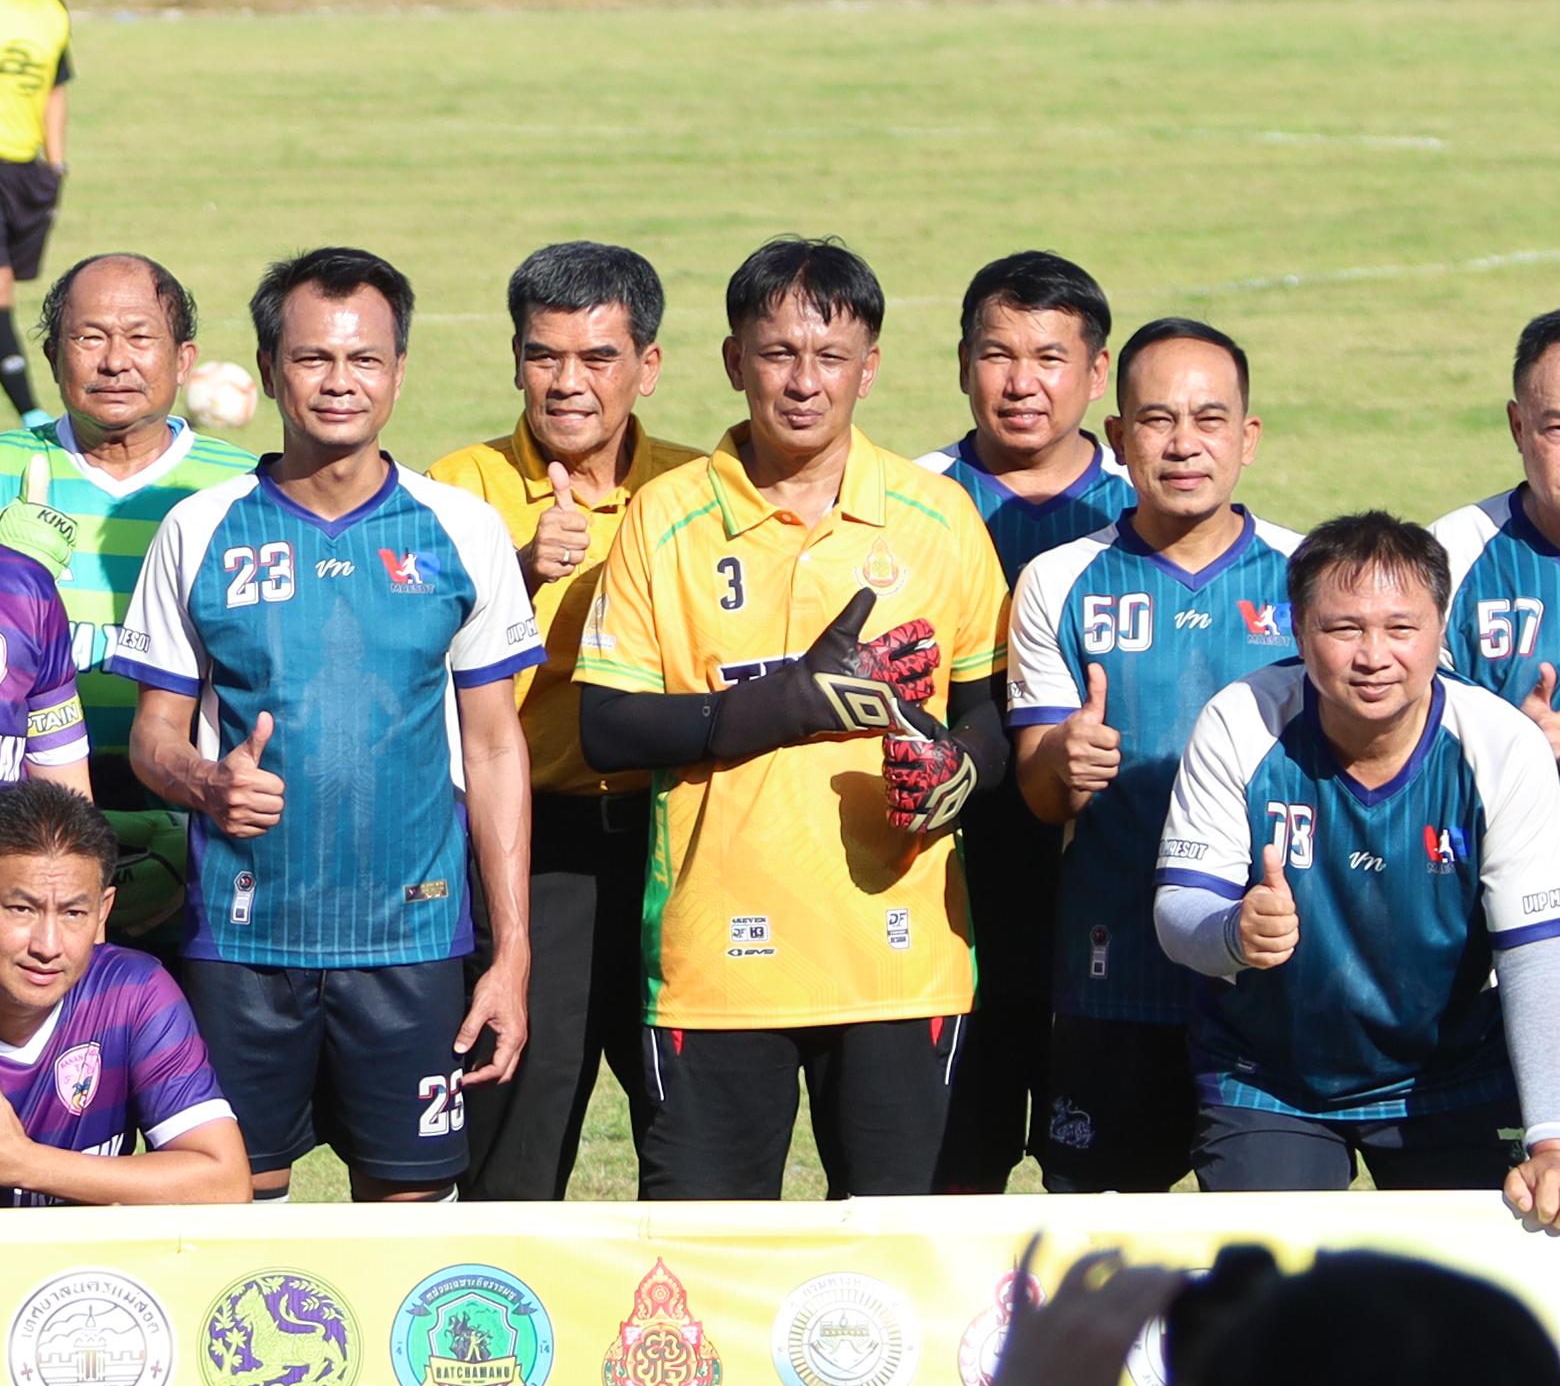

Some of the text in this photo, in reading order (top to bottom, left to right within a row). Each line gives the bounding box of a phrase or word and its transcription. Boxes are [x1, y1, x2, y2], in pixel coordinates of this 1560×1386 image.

[223, 541, 297, 609] 23
[716, 556, 746, 611] 3
[1082, 592, 1153, 654] 50
[1476, 596, 1545, 661] 57
[1523, 892, 1548, 915] VIP
[418, 1068, 465, 1137] 23
[436, 1365, 510, 1379] RATCHAMANU
